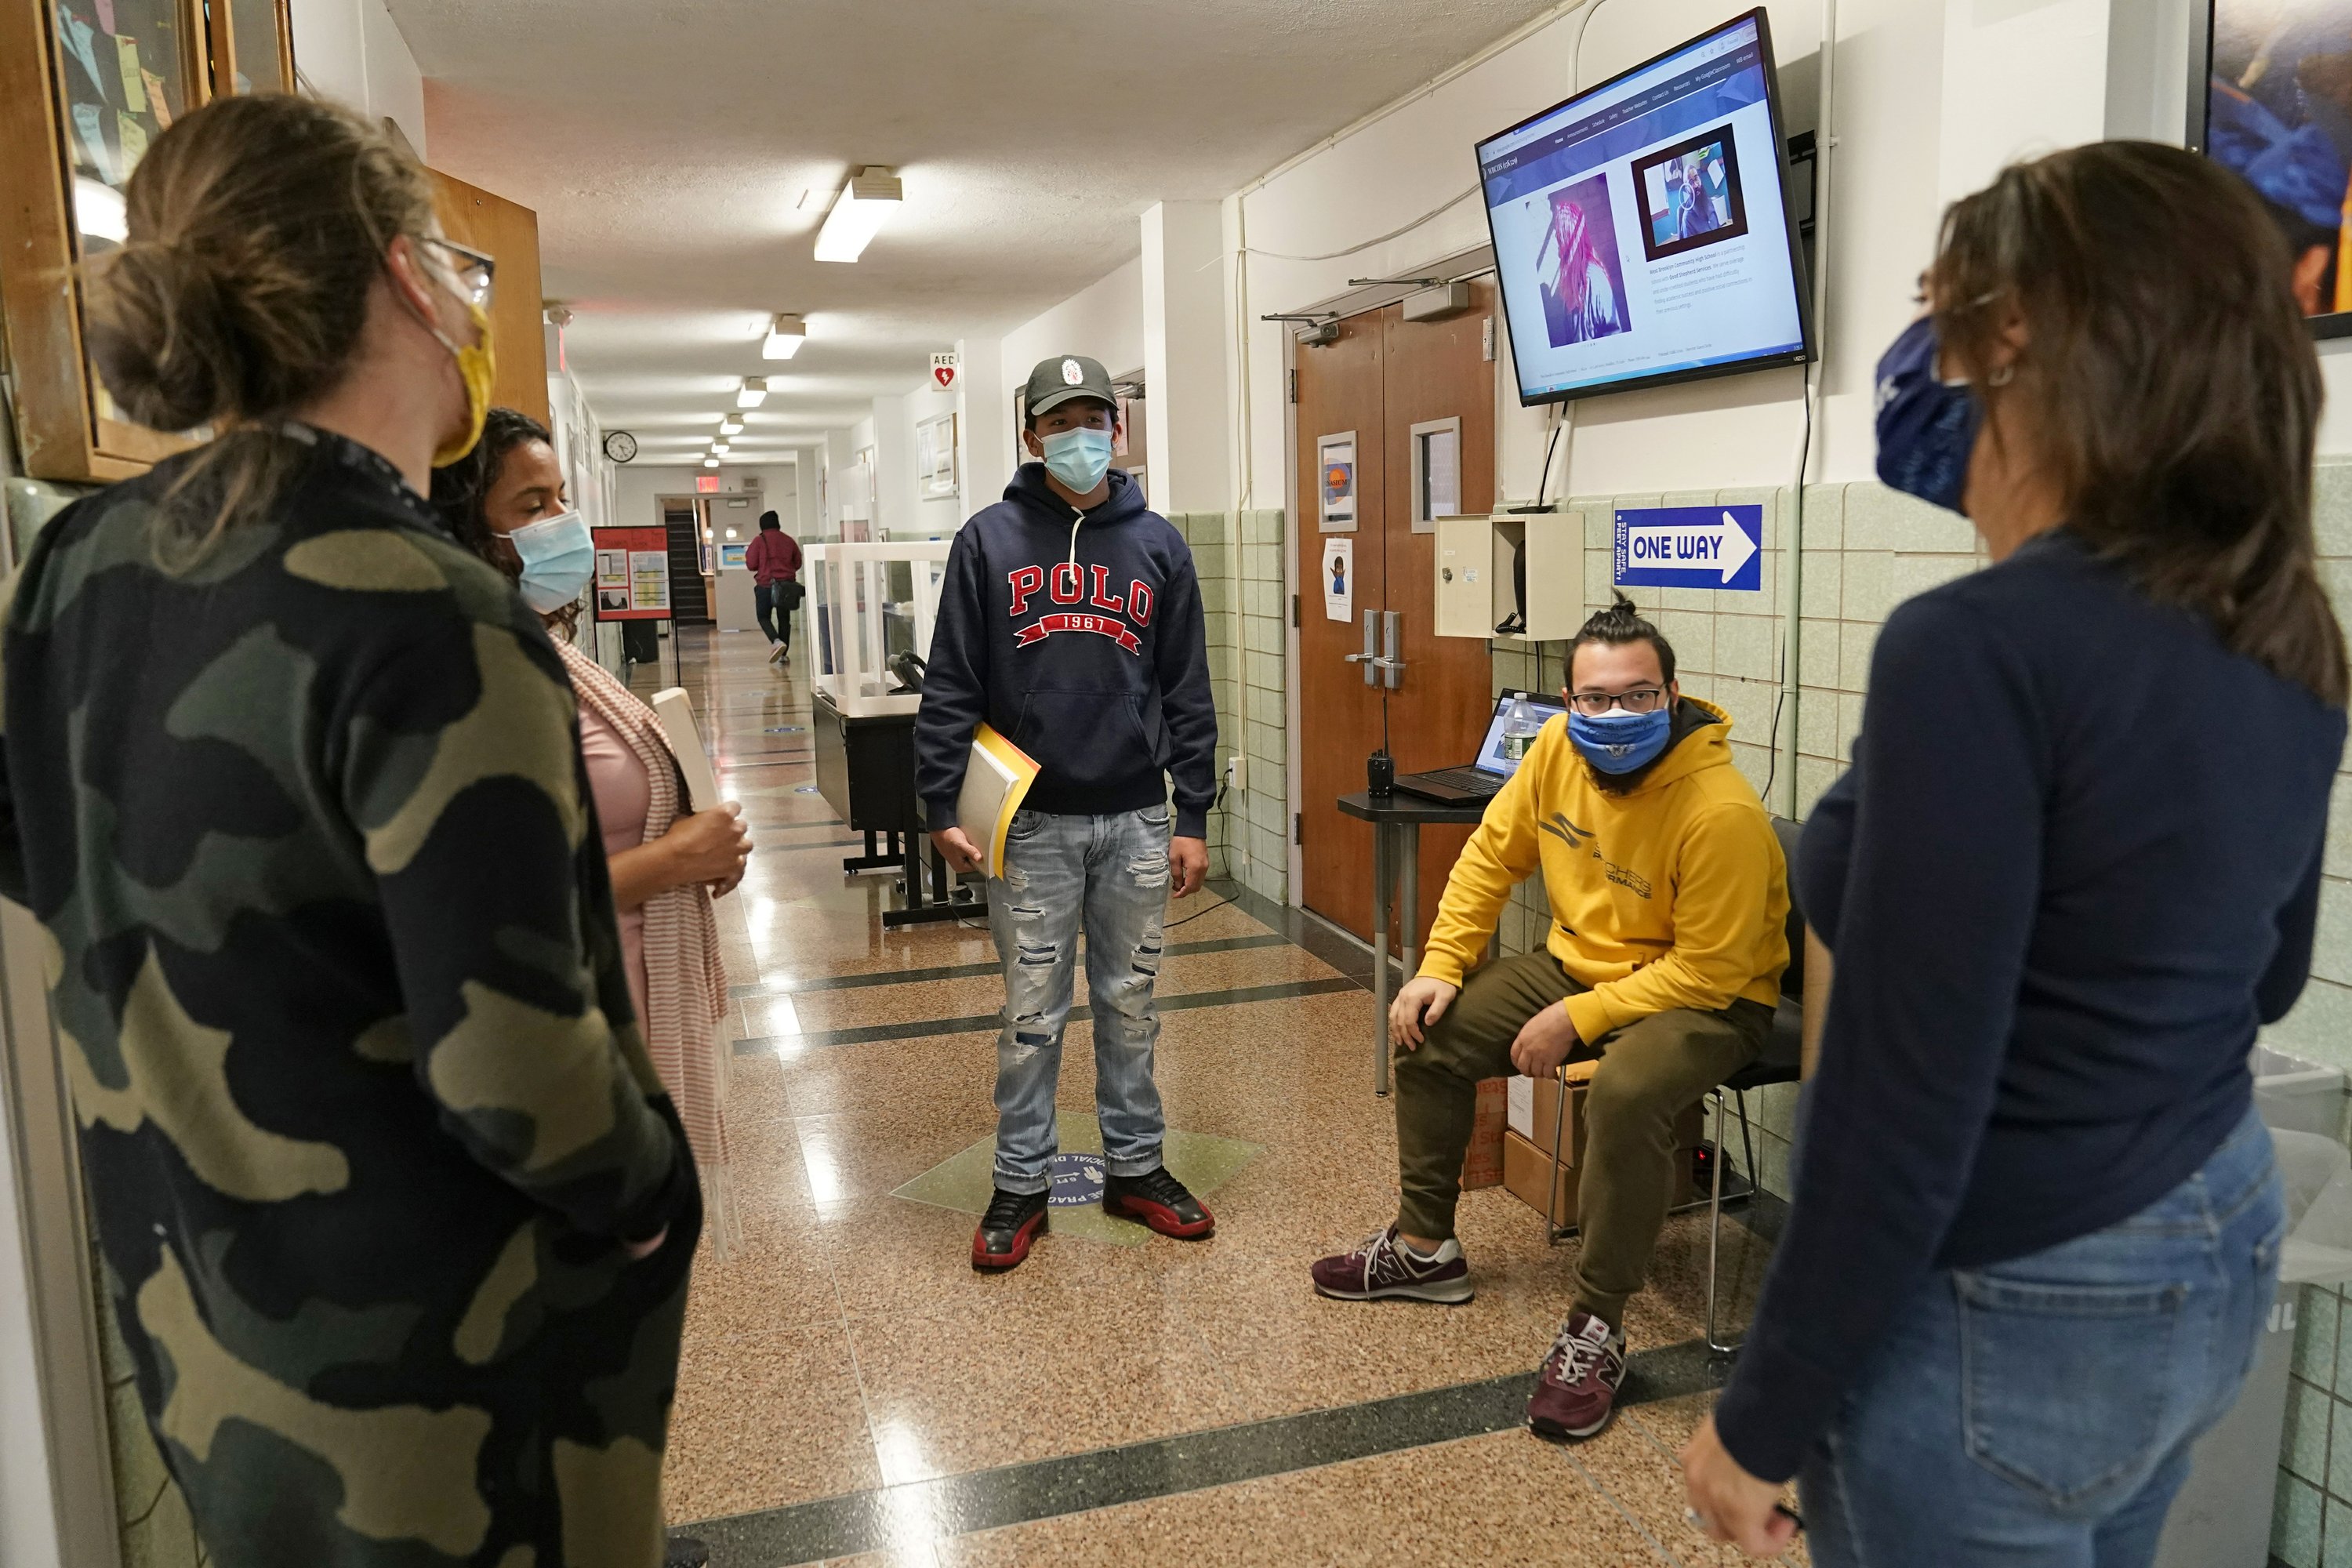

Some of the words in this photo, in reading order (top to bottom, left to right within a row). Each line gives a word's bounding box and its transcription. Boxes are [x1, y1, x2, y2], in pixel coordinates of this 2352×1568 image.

[1592, 118, 1605, 127] Schedule
[1652, 93, 1664, 101] Contact
[1674, 81, 1690, 91] Resources
[1704, 252, 1717, 260] School
[934, 355, 955, 365] AED
[1634, 536, 1671, 559] ONE
[1677, 535, 1723, 559] WAY
[1008, 562, 1154, 627] POLO
[1064, 615, 1104, 631] 1967
